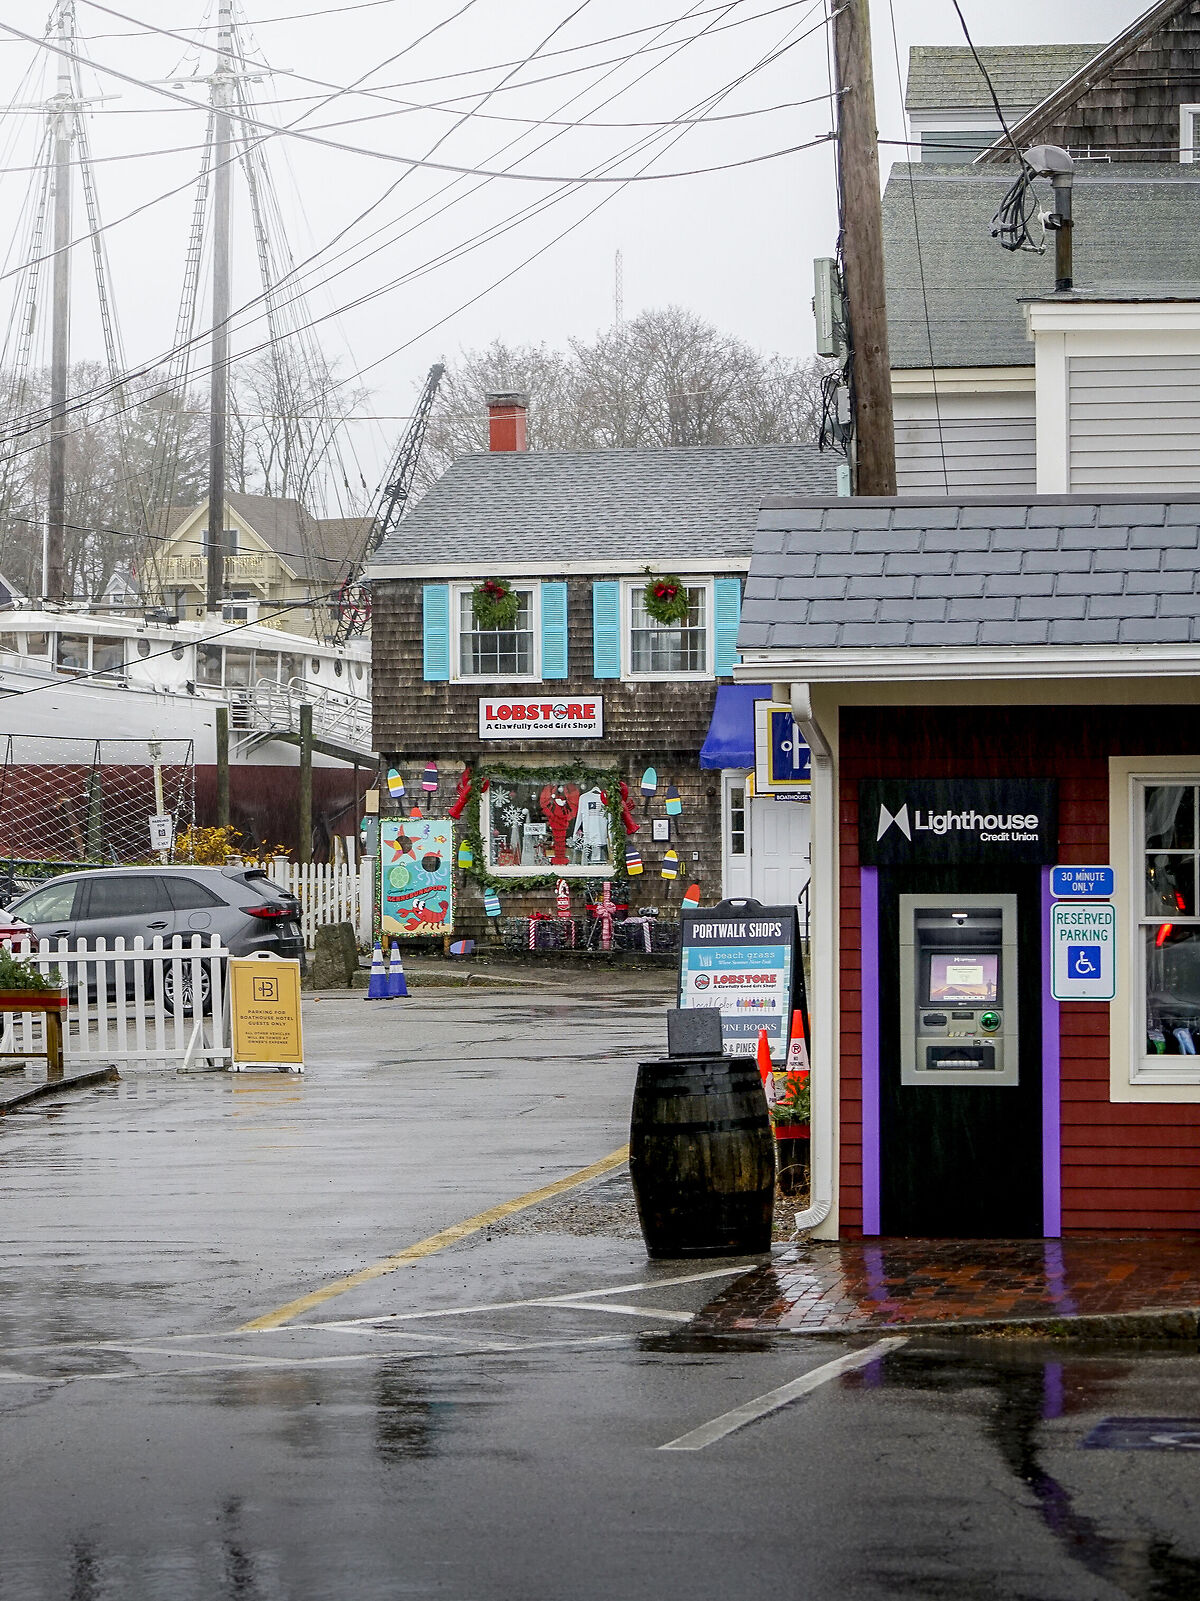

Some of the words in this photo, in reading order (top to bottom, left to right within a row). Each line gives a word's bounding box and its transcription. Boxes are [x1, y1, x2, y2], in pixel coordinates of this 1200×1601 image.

[485, 703, 596, 721] LOBSTORE
[494, 723, 532, 731] Clawfully
[915, 810, 1039, 835] Lighthouse
[980, 832, 1010, 841] Credit
[1011, 832, 1039, 841] Union
[1061, 872, 1073, 881] 30
[1075, 872, 1106, 882] MINUTE
[1072, 882, 1095, 892] ONLY
[1056, 912, 1112, 925] RESERVED
[692, 923, 746, 939] PORTWALK
[748, 922, 782, 937] SHOPS
[1059, 929, 1109, 942] PARKING
[715, 951, 744, 959] beach
[747, 952, 775, 960] grass
[713, 974, 777, 984] LOBSTORE
[743, 1022, 777, 1031] BOOKS
[735, 1042, 756, 1053] PINES
